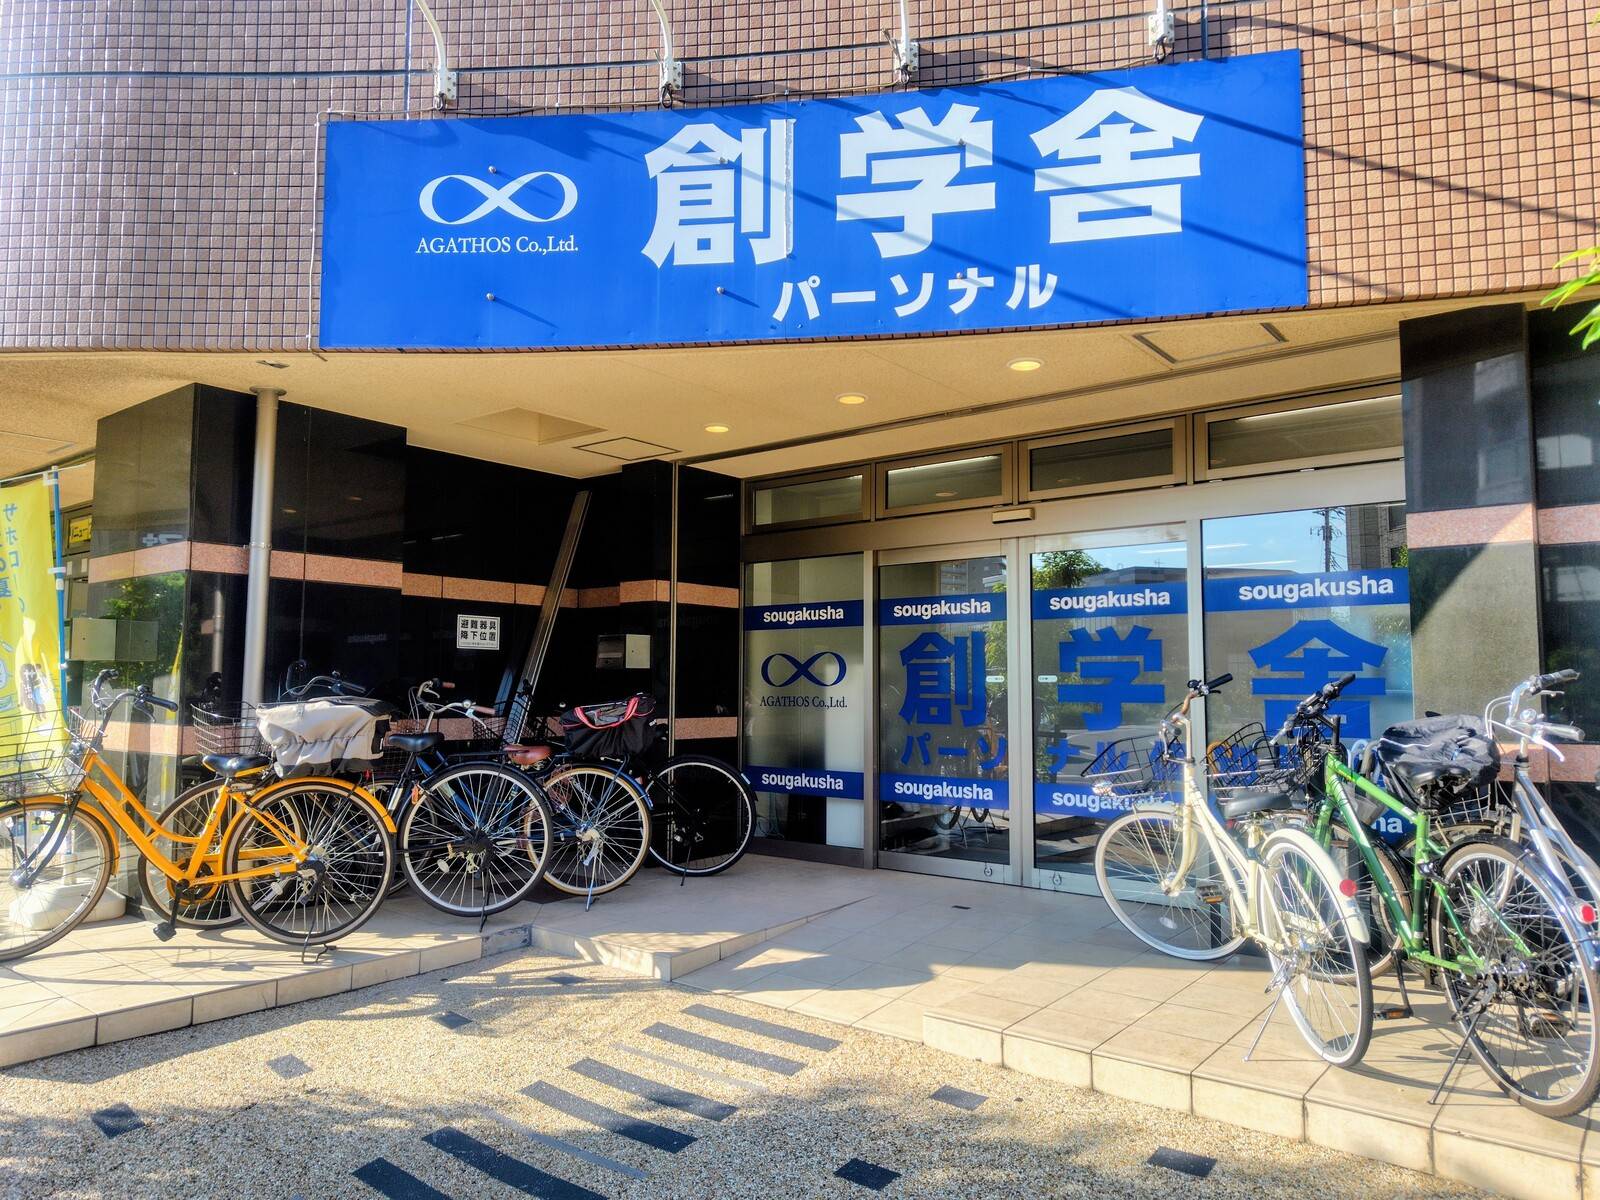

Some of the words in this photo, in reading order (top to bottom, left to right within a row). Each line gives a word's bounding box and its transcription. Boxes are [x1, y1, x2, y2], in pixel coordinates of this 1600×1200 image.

[641, 86, 1205, 268] 創学舎
[416, 237, 511, 254] AGATHOS
[516, 235, 579, 255] Co.,Ltd.
[772, 264, 1058, 322] パーソナル
[1050, 588, 1171, 612] sougakusha
[1238, 575, 1394, 603] sougakusha
[763, 606, 844, 625] sougakusha
[893, 598, 991, 620] sougakusha
[899, 619, 1389, 739] 創学舎
[760, 695, 809, 708] AGATHOS
[812, 695, 848, 712] Co.,Ltd.
[761, 771, 844, 791] sougakusha
[894, 779, 994, 801] sougakusha
